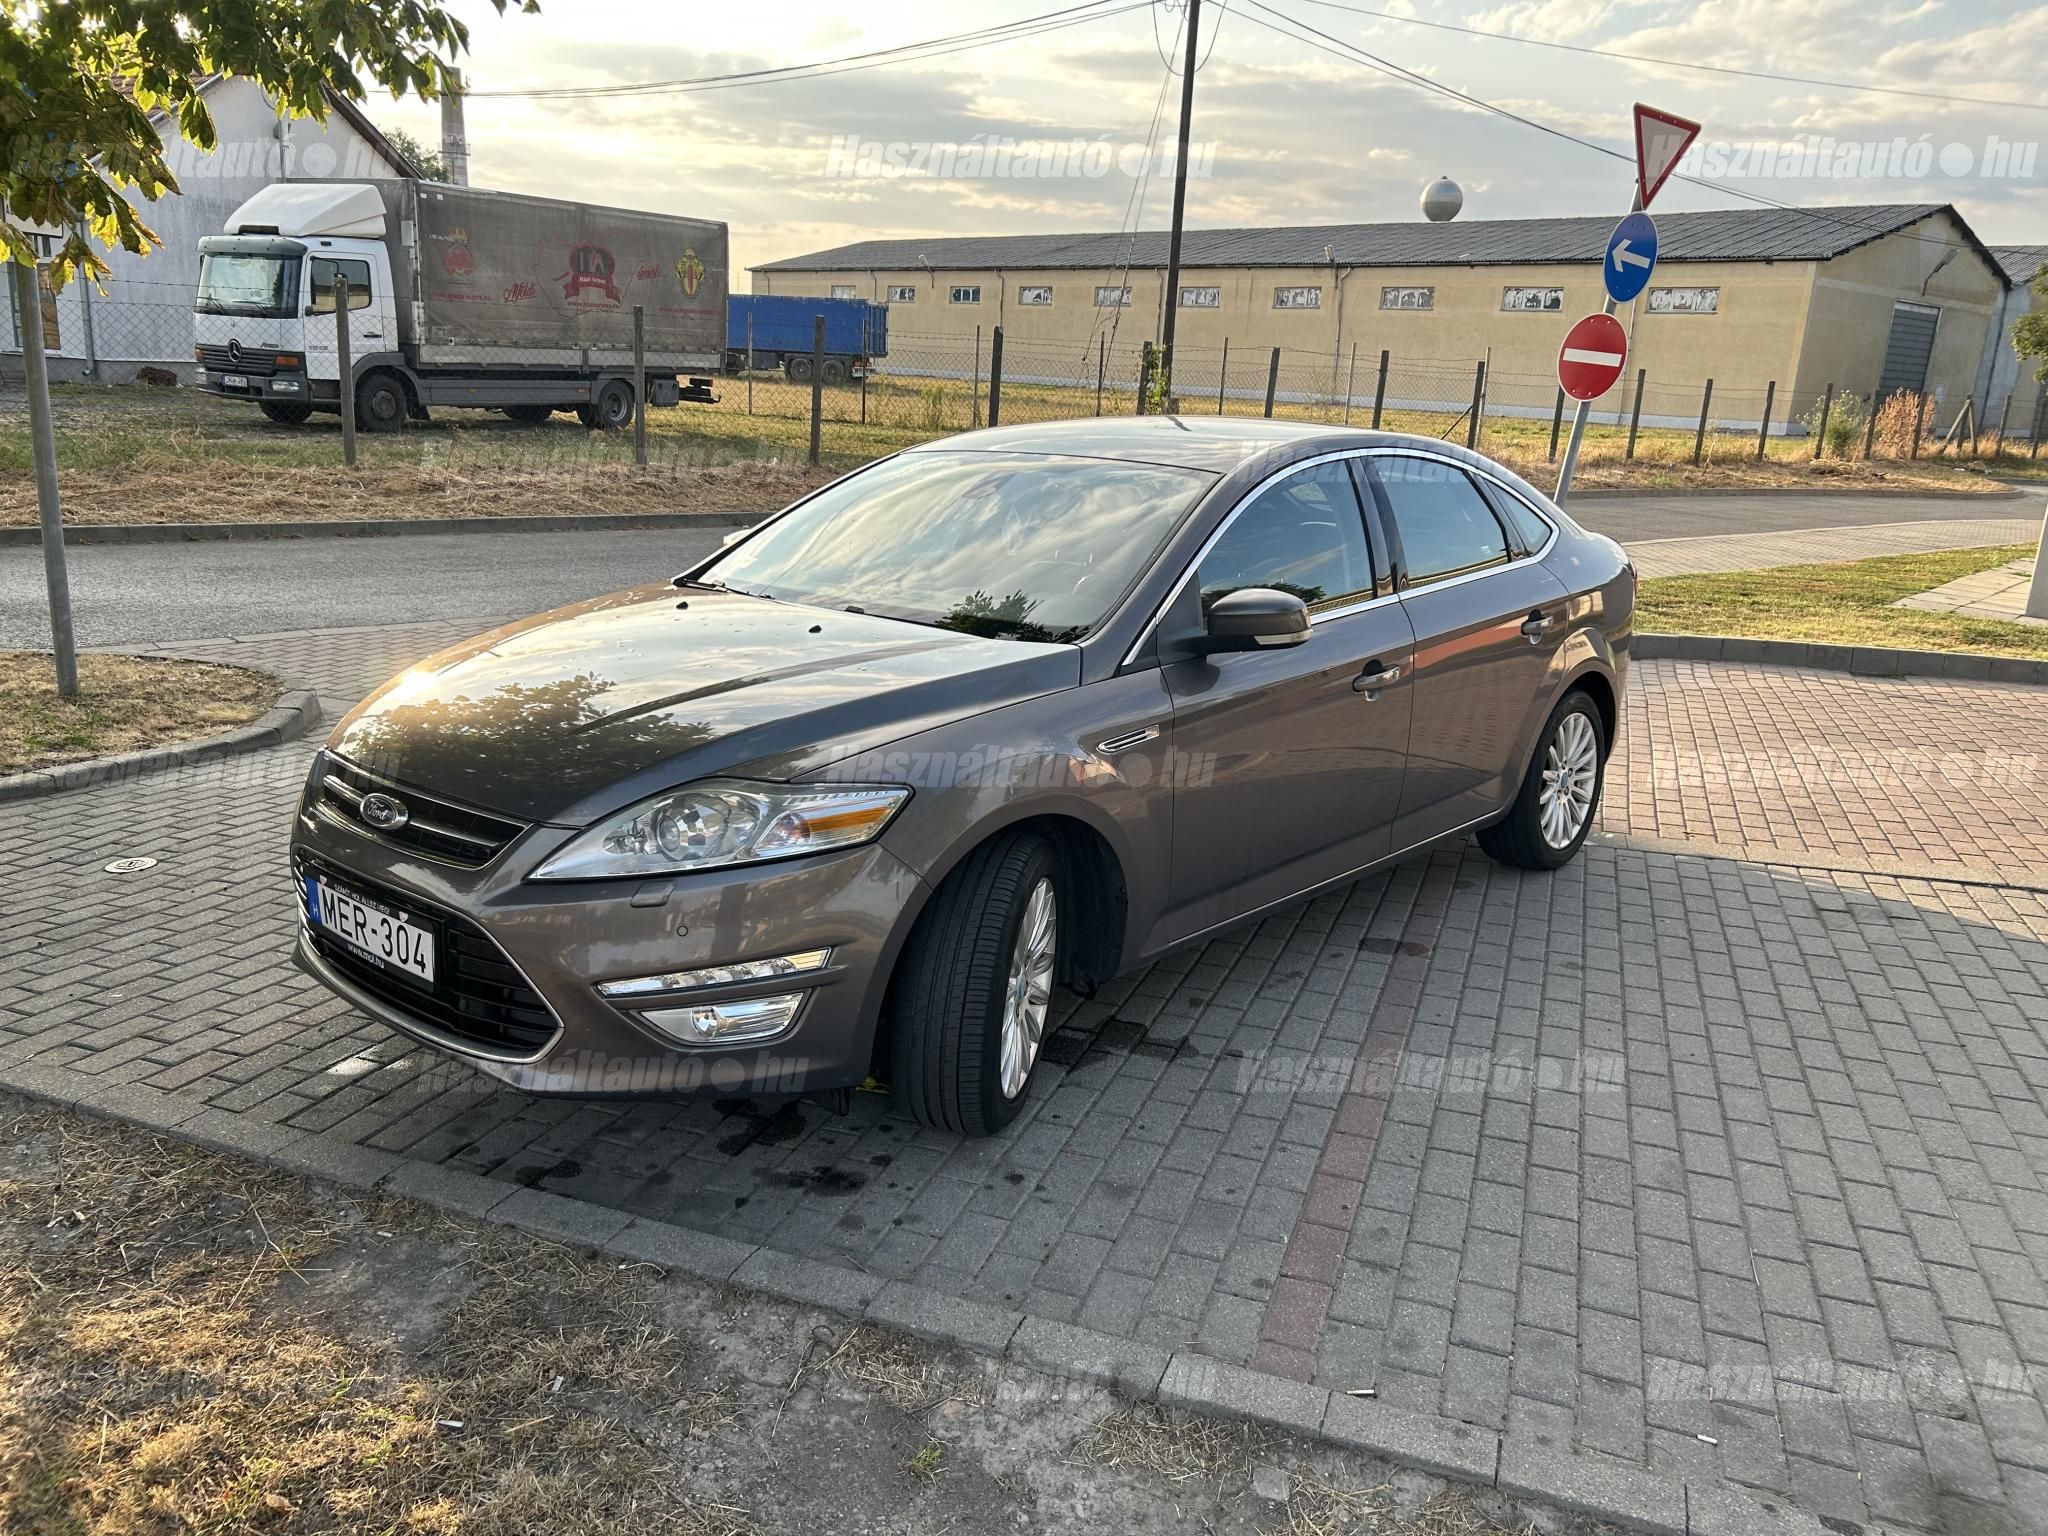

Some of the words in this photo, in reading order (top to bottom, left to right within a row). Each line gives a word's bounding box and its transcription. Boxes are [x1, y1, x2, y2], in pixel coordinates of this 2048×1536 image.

[368, 798, 389, 820] Ford
[312, 903, 320, 917] H
[321, 888, 427, 974] MER-304
